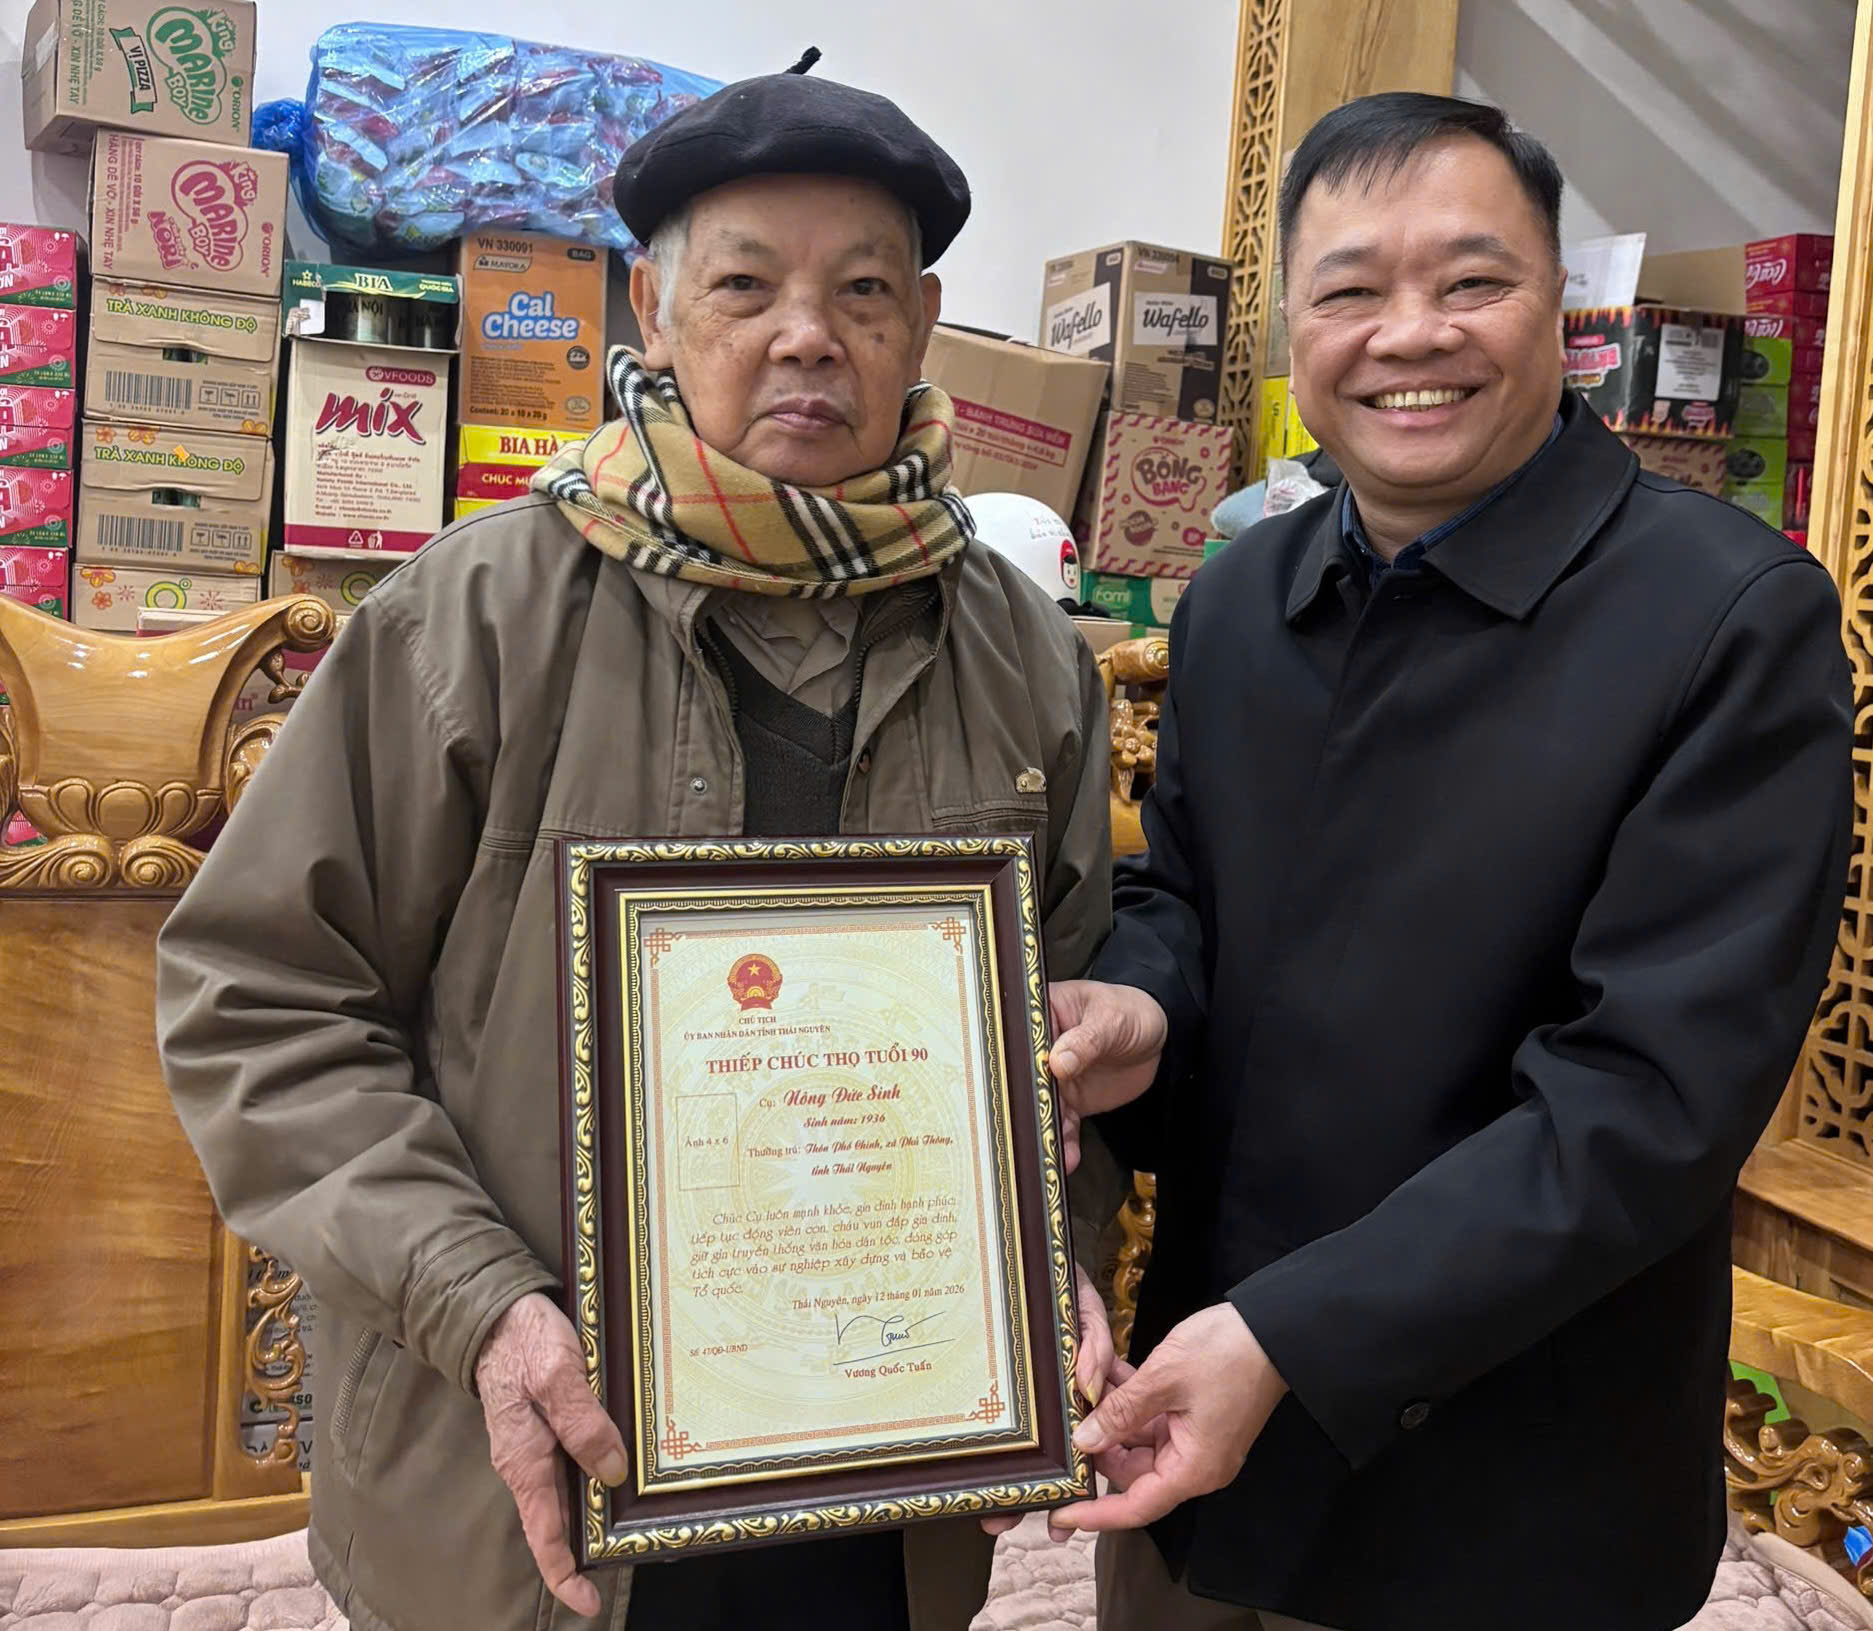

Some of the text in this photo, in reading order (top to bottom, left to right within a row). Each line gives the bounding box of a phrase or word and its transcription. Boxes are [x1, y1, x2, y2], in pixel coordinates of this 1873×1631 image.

[70, 46, 81, 63] XIN
[68, 64, 81, 85] NHẸ
[133, 59, 152, 92] PIZZA
[70, 86, 80, 104] TAY
[165, 73, 188, 111] BOY
[231, 89, 242, 129] ORION
[105, 207, 115, 224] XIN
[101, 226, 114, 248] NHẸ
[189, 223, 212, 257] BOY
[477, 238, 533, 253] VN 330091
[104, 251, 114, 270] TAY
[261, 234, 272, 275] ORION
[354, 273, 393, 291] BIA
[106, 298, 258, 333] TRÀ XANH KHÔNG ĐỘ
[509, 291, 554, 318] Cal
[483, 312, 579, 339] Cheese
[1051, 301, 1103, 351] Wafello
[1142, 304, 1209, 337] Wafello
[499, 434, 559, 456] BIA HÀ
[94, 445, 123, 462] TRÀ
[124, 449, 166, 467] XANH
[222, 458, 245, 475] ĐỘ
[1152, 481, 1190, 497] BANG
[705, 1042, 928, 1074] THIẾP CHÚC THỌ TUỔI 90
[866, 1083, 901, 1101] Sinh
[803, 1116, 828, 1128] Sinh
[860, 1113, 886, 1125] 1936
[766, 1208, 789, 1221] luôn
[792, 1205, 820, 1220] mạnh
[854, 1203, 871, 1217] gia
[900, 1197, 925, 1212] hạnh
[720, 1231, 740, 1244] tục
[777, 1225, 801, 1237] viên
[832, 1219, 859, 1233] cháu
[863, 1219, 882, 1230] vun
[911, 1214, 928, 1229] gia
[934, 1230, 958, 1245] góp
[790, 1258, 830, 1274] nghiệp
[938, 1246, 953, 1259] vệ
[792, 1299, 812, 1310] Thái
[851, 1293, 873, 1306] ngày
[874, 1292, 885, 1302] 12
[887, 1289, 910, 1302] tháng
[911, 1288, 922, 1298] 01
[923, 1287, 942, 1297] năm
[944, 1284, 965, 1295] 2026
[844, 1359, 932, 1378] Vương Quốc Tuấn
